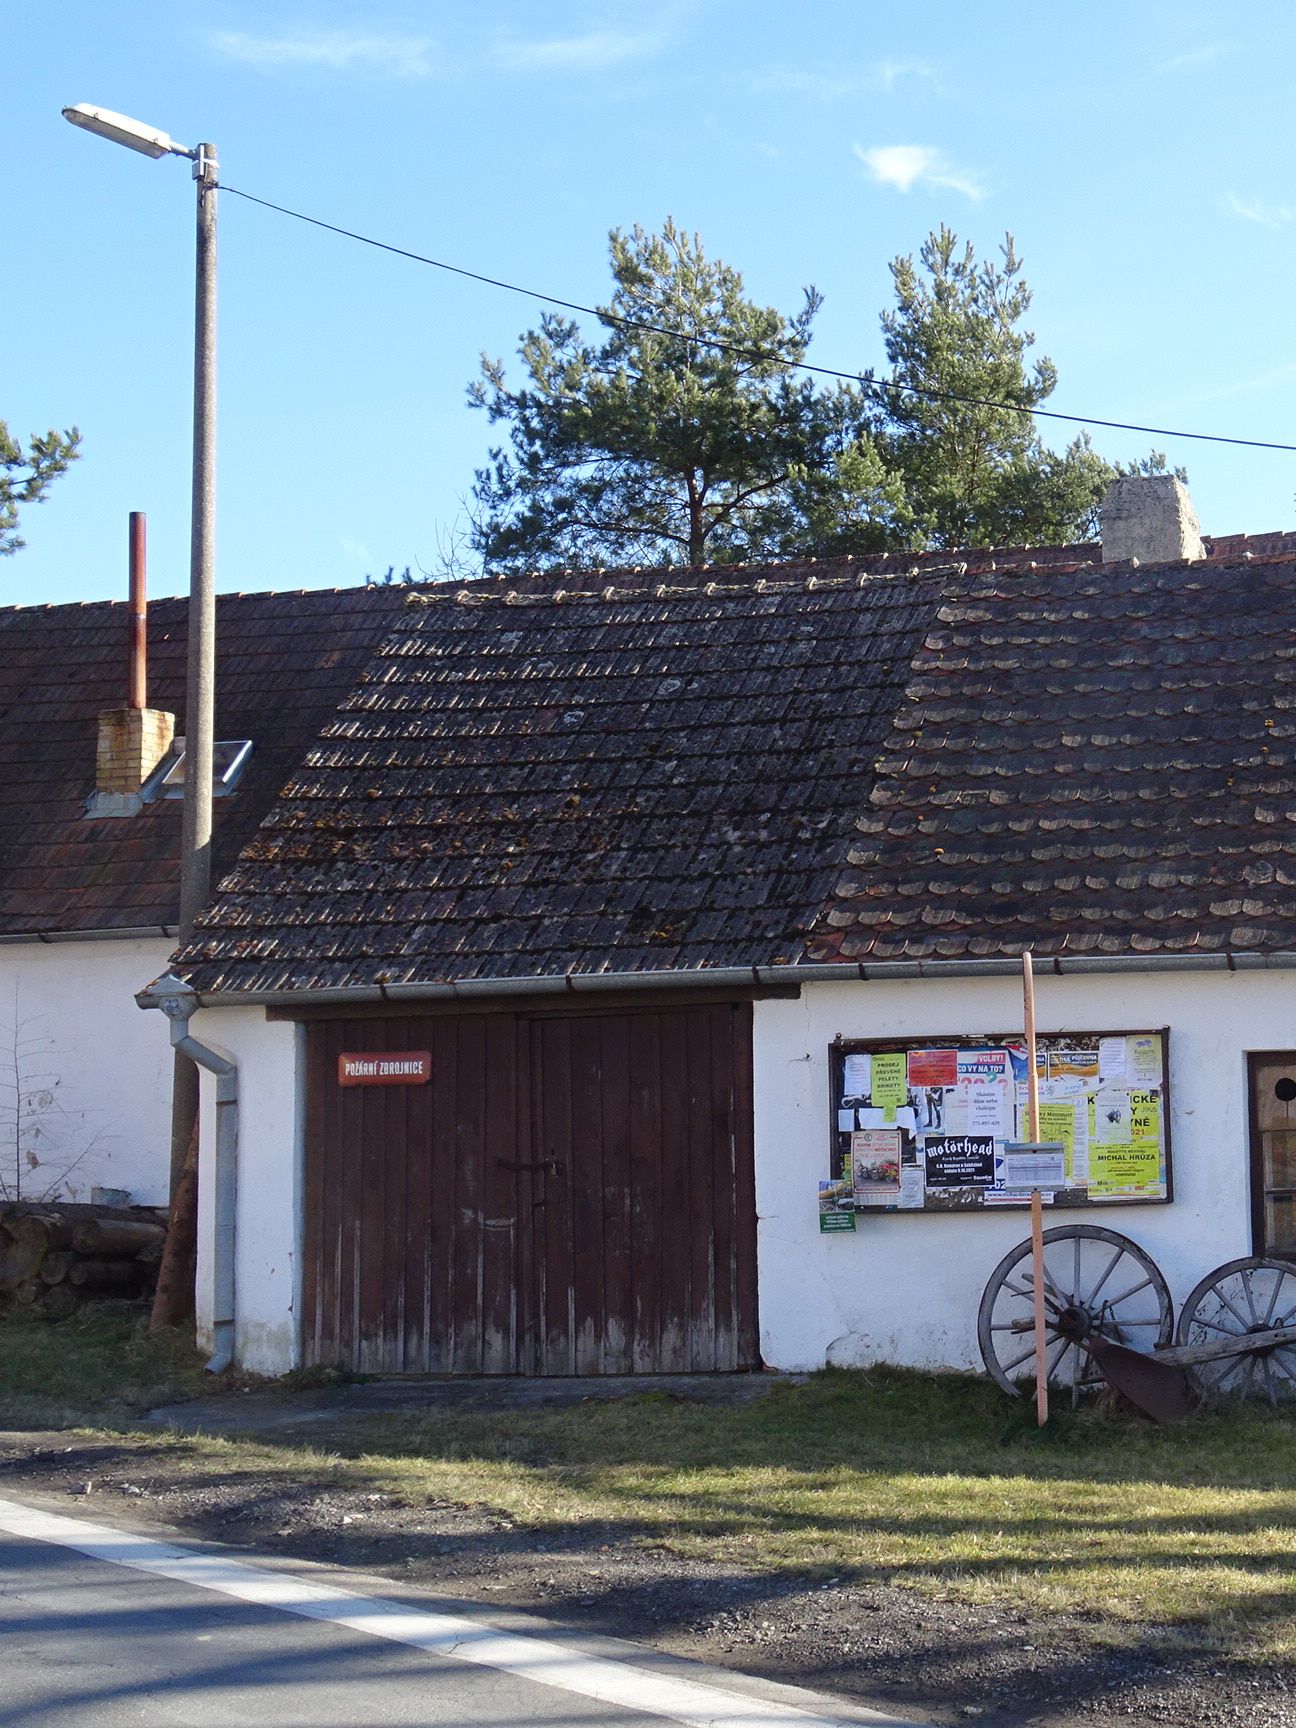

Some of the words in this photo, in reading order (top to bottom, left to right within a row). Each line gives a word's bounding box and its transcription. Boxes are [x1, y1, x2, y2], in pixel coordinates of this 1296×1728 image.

[979, 1054, 1003, 1062] VOLBY!
[345, 1060, 378, 1076] POŽÁRNÍ
[380, 1061, 423, 1075] ZBROJNICE
[989, 1064, 1003, 1072] TO?
[926, 1137, 993, 1158] motörhead
[1129, 1152, 1156, 1161] HRŮZA
